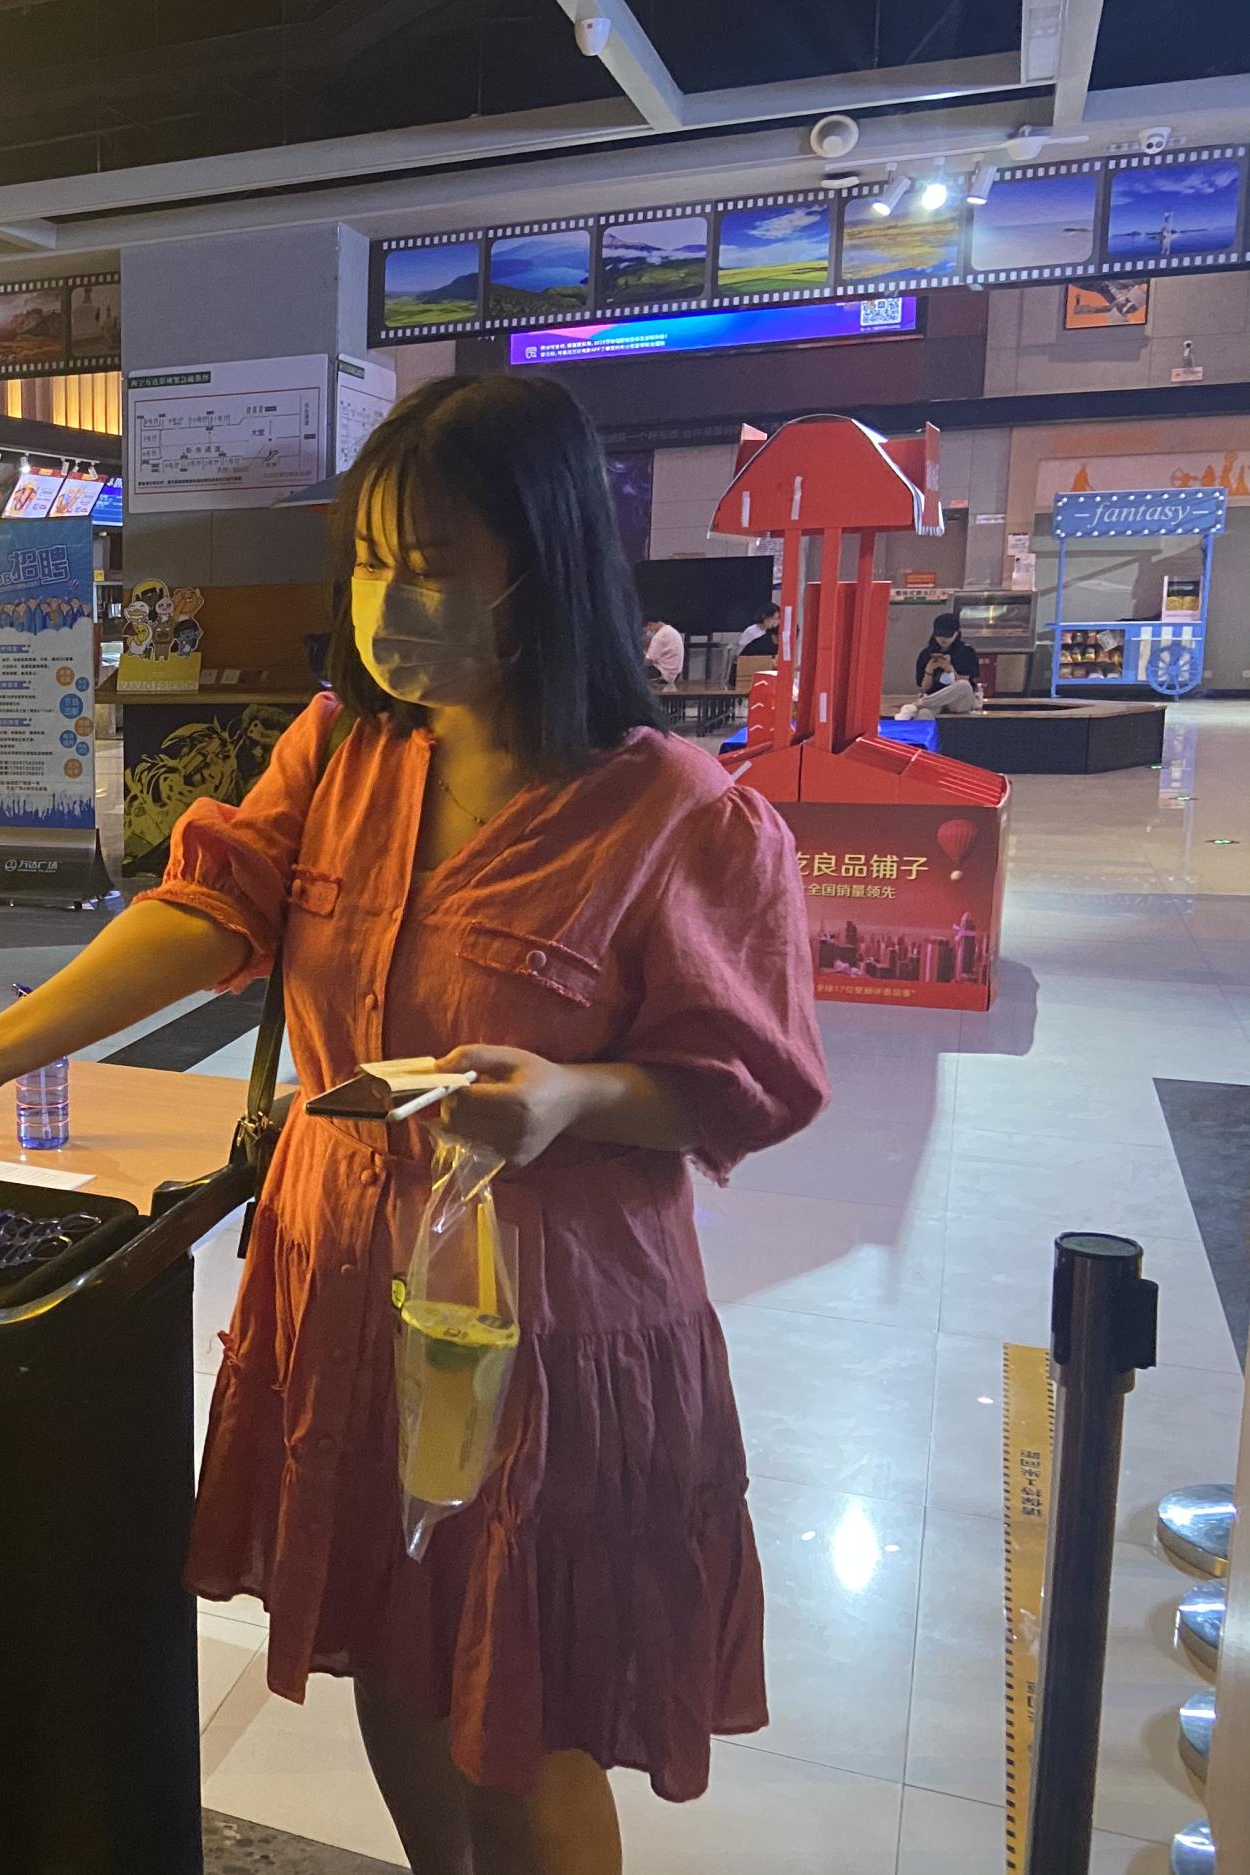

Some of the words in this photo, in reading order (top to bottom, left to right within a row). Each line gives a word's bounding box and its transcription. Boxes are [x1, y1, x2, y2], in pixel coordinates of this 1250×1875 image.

[1086, 501, 1191, 529] fantasy
[9, 545, 71, 585] 招聘
[807, 883, 897, 899] 全国销量领先
